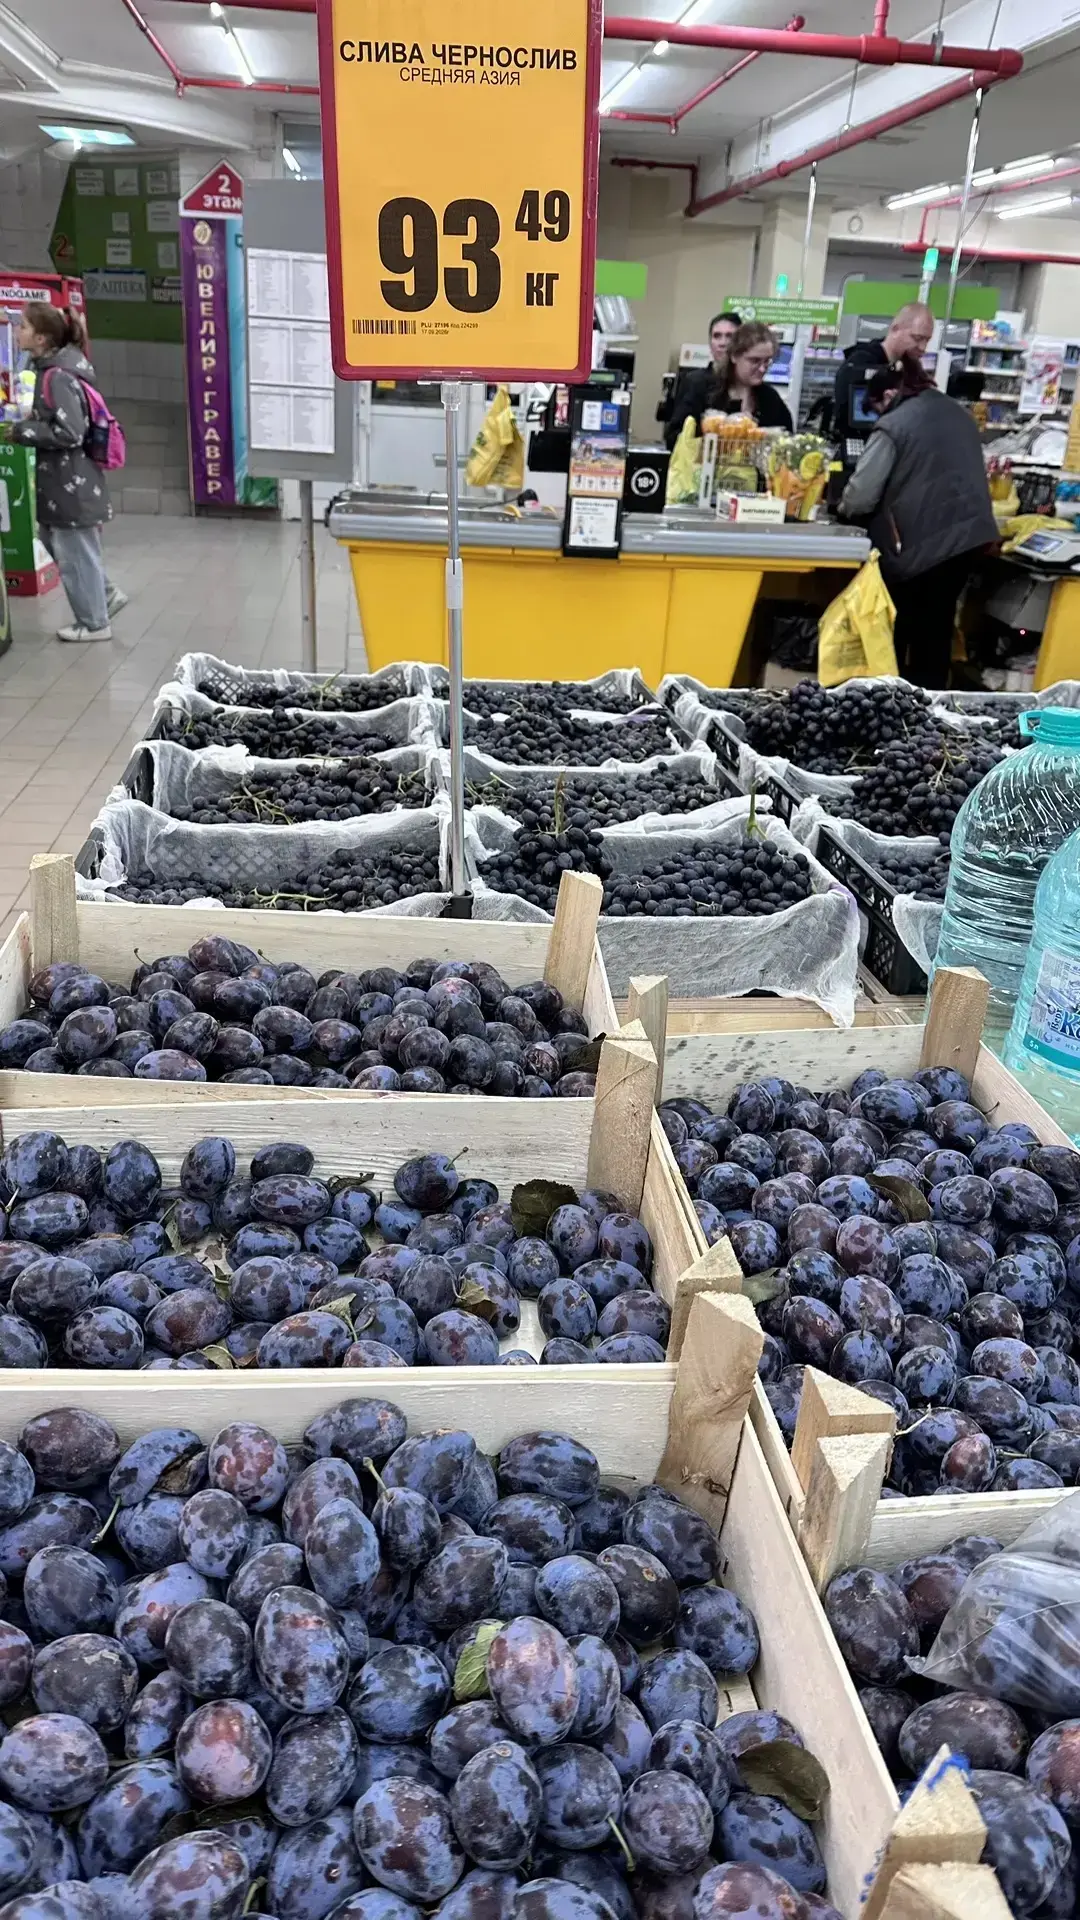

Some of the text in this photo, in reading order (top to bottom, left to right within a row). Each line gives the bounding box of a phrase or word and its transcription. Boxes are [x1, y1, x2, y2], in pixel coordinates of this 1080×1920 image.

[339, 40, 578, 70] СЛИВА ЧЕРНОСЛИВ
[399, 67, 521, 86] СРЕДНЯЯ АЗИЯ
[217, 174, 232, 193] 2
[515, 189, 570, 243] 49
[378, 196, 501, 313] 93
[525, 272, 559, 306] КГ
[195, 263, 218, 371] ЮВЕЛИР
[203, 390, 224, 495] ГРАВЕР
[636, 475, 654, 488] 18+
